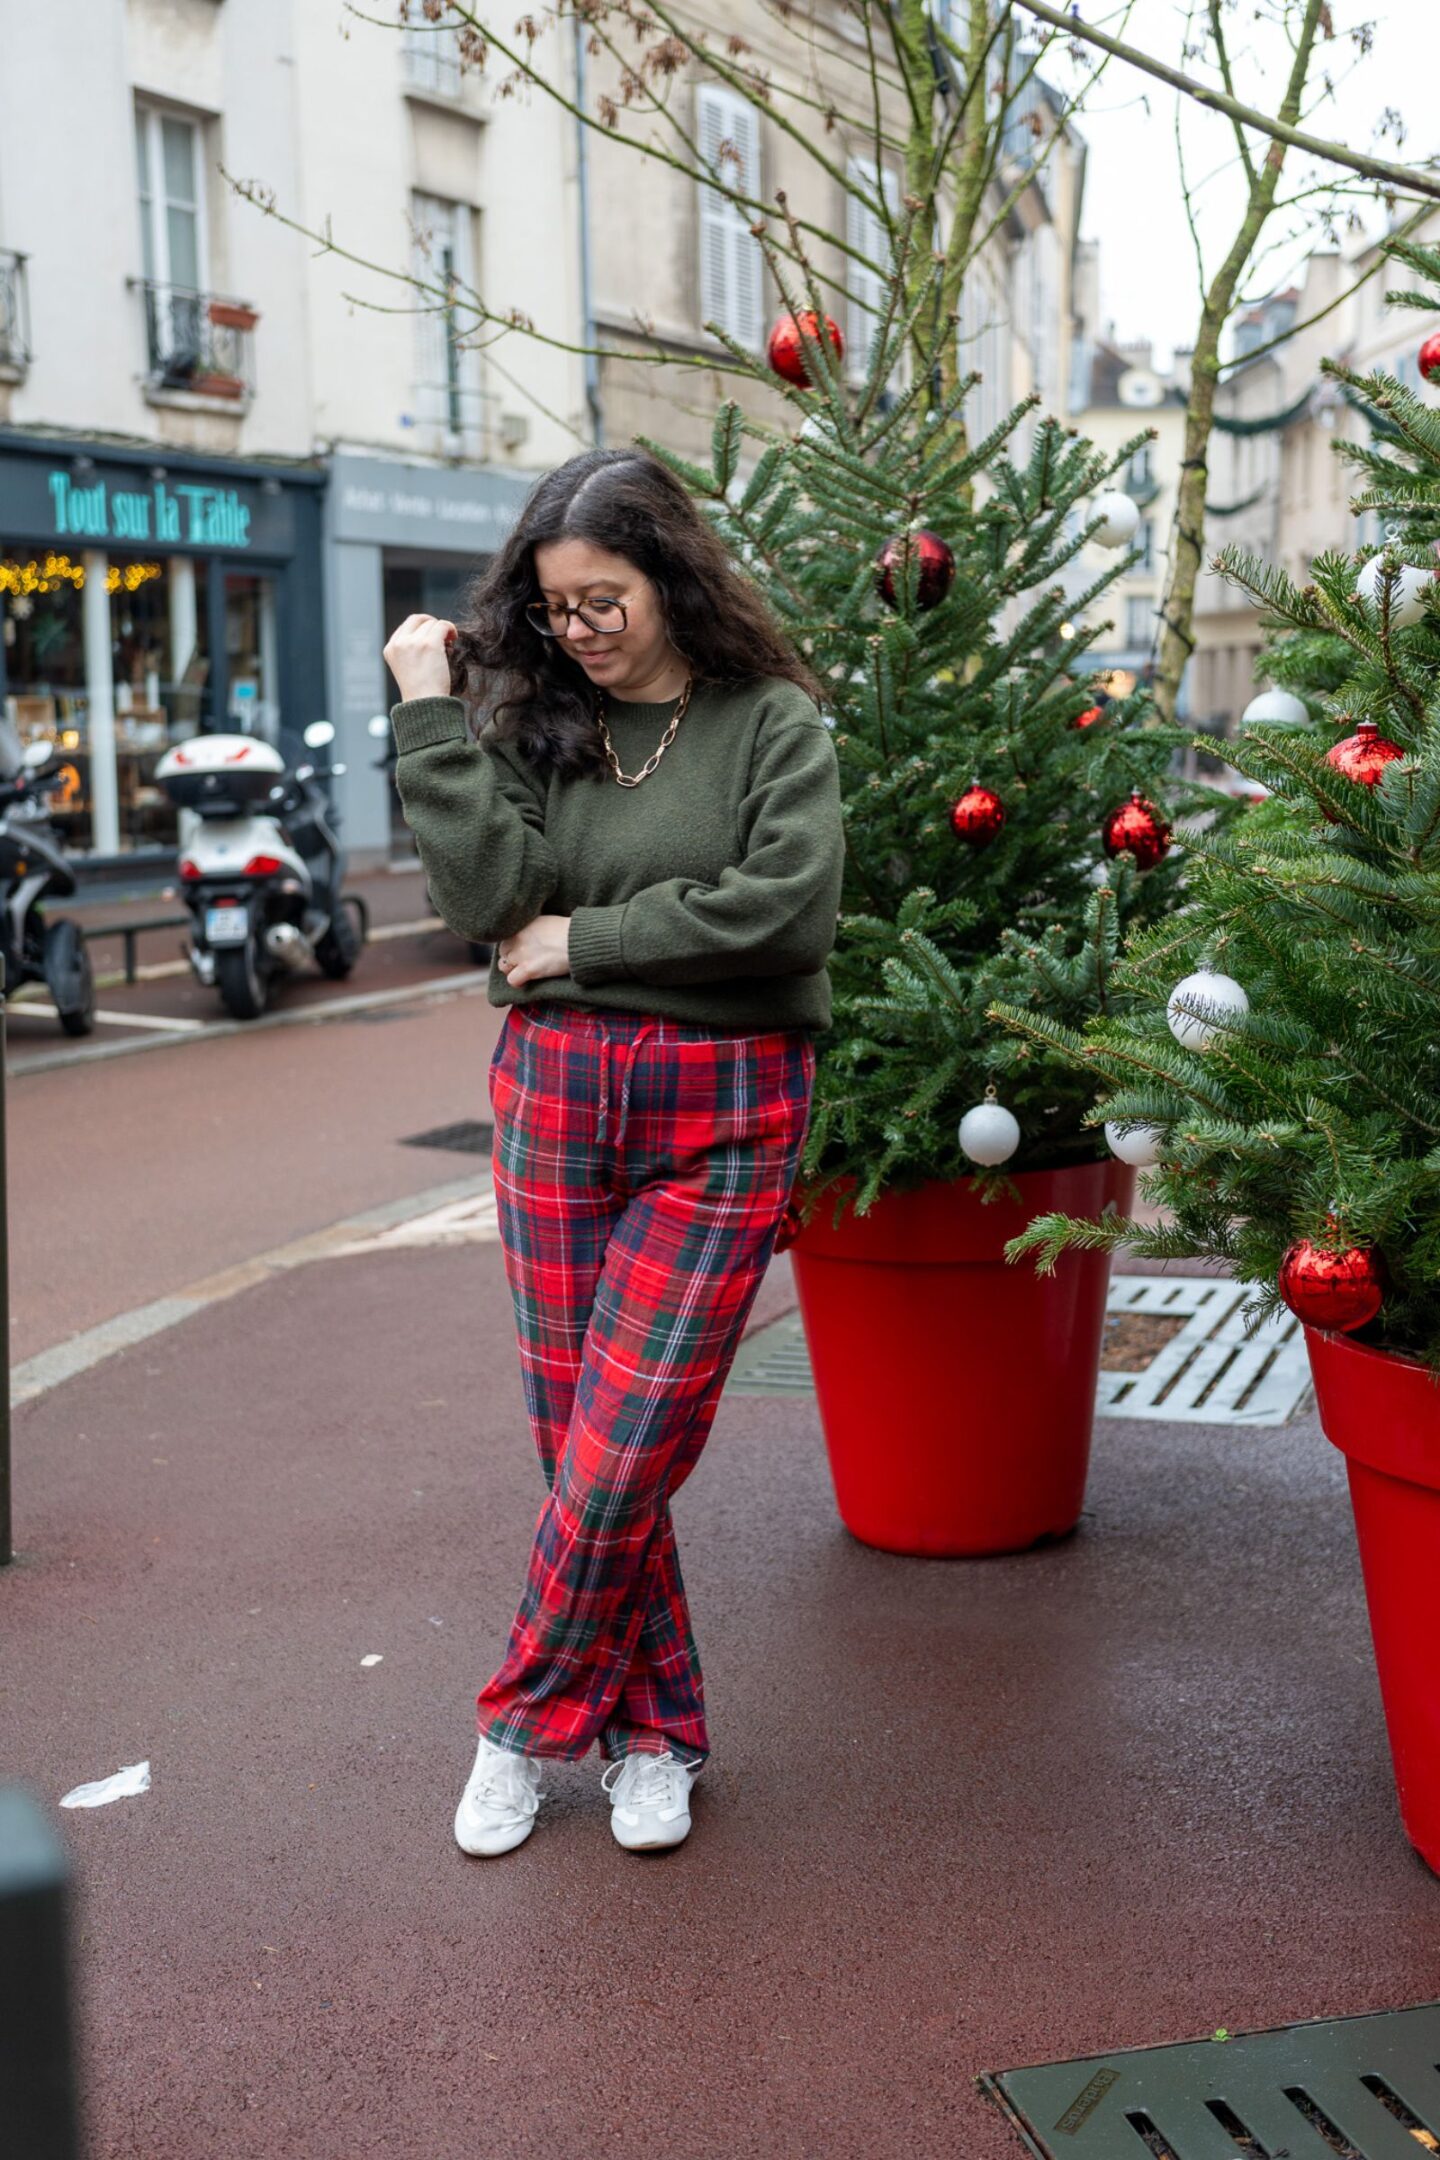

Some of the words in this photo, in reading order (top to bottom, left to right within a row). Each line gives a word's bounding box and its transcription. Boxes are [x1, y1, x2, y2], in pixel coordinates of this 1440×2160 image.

[48, 471, 108, 536] Tout
[112, 491, 152, 540] sur
[153, 482, 180, 542] la
[175, 484, 250, 548] Table
